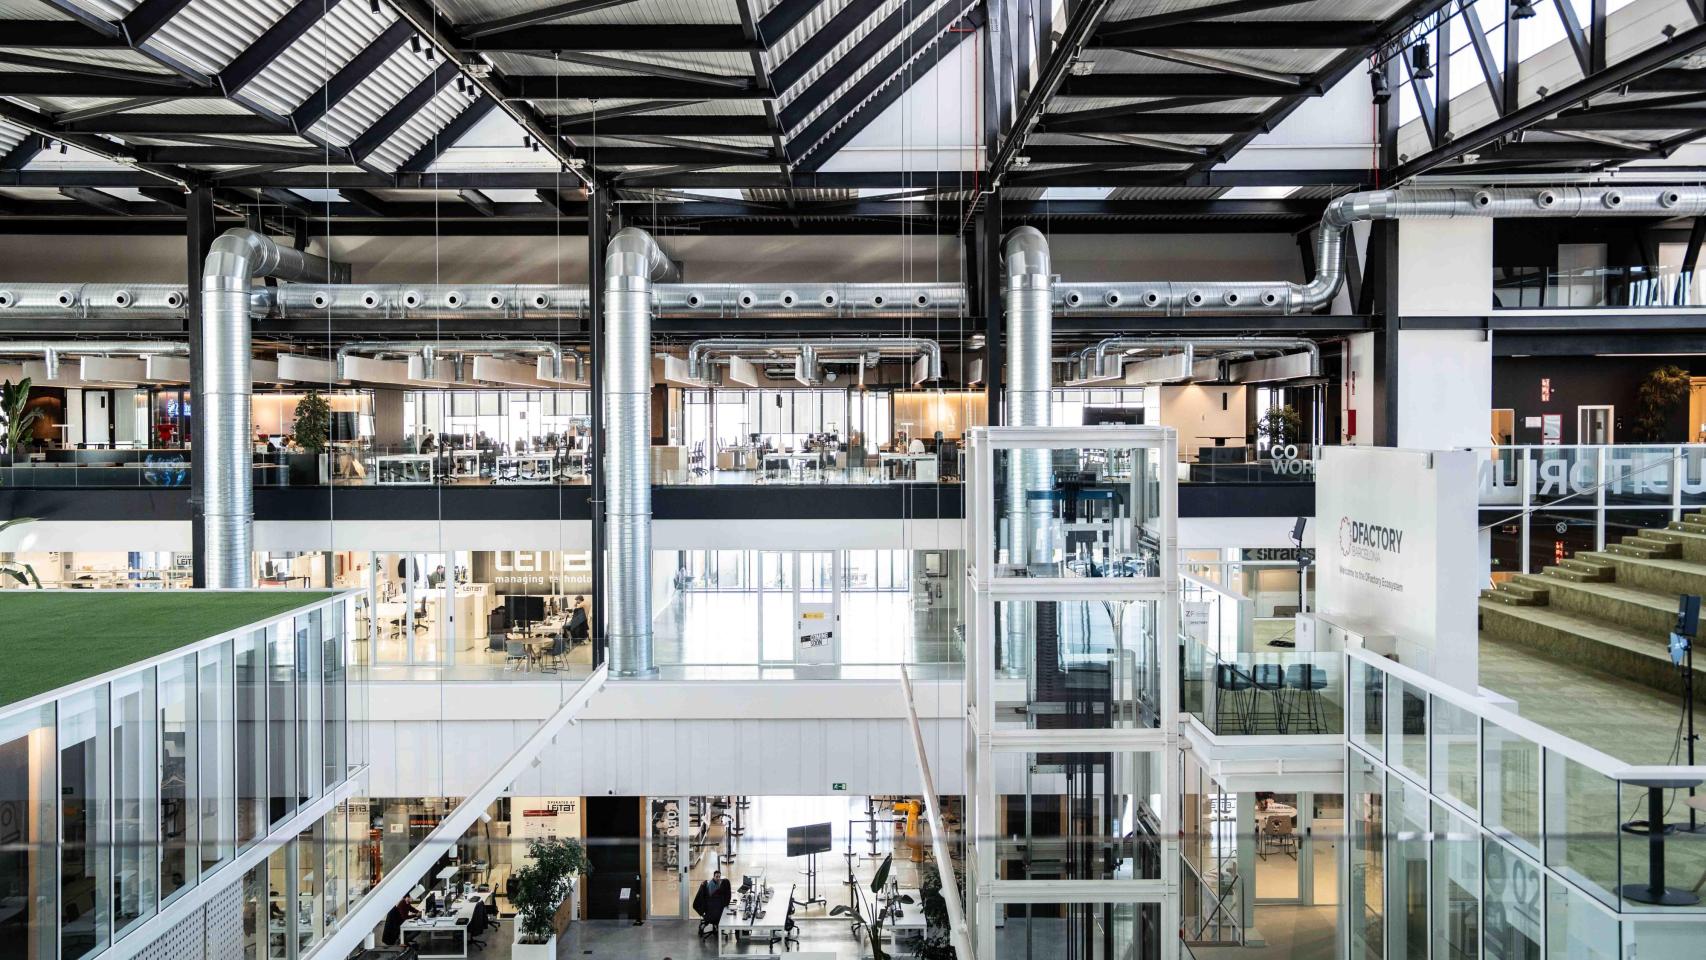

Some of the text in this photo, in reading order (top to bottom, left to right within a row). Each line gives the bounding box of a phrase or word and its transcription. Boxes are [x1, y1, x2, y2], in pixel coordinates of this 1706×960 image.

[1271, 444, 1298, 460] CO
[1271, 460, 1314, 474] WOR
[1352, 520, 1403, 554] DFACTORY
[495, 574, 544, 584] managing
